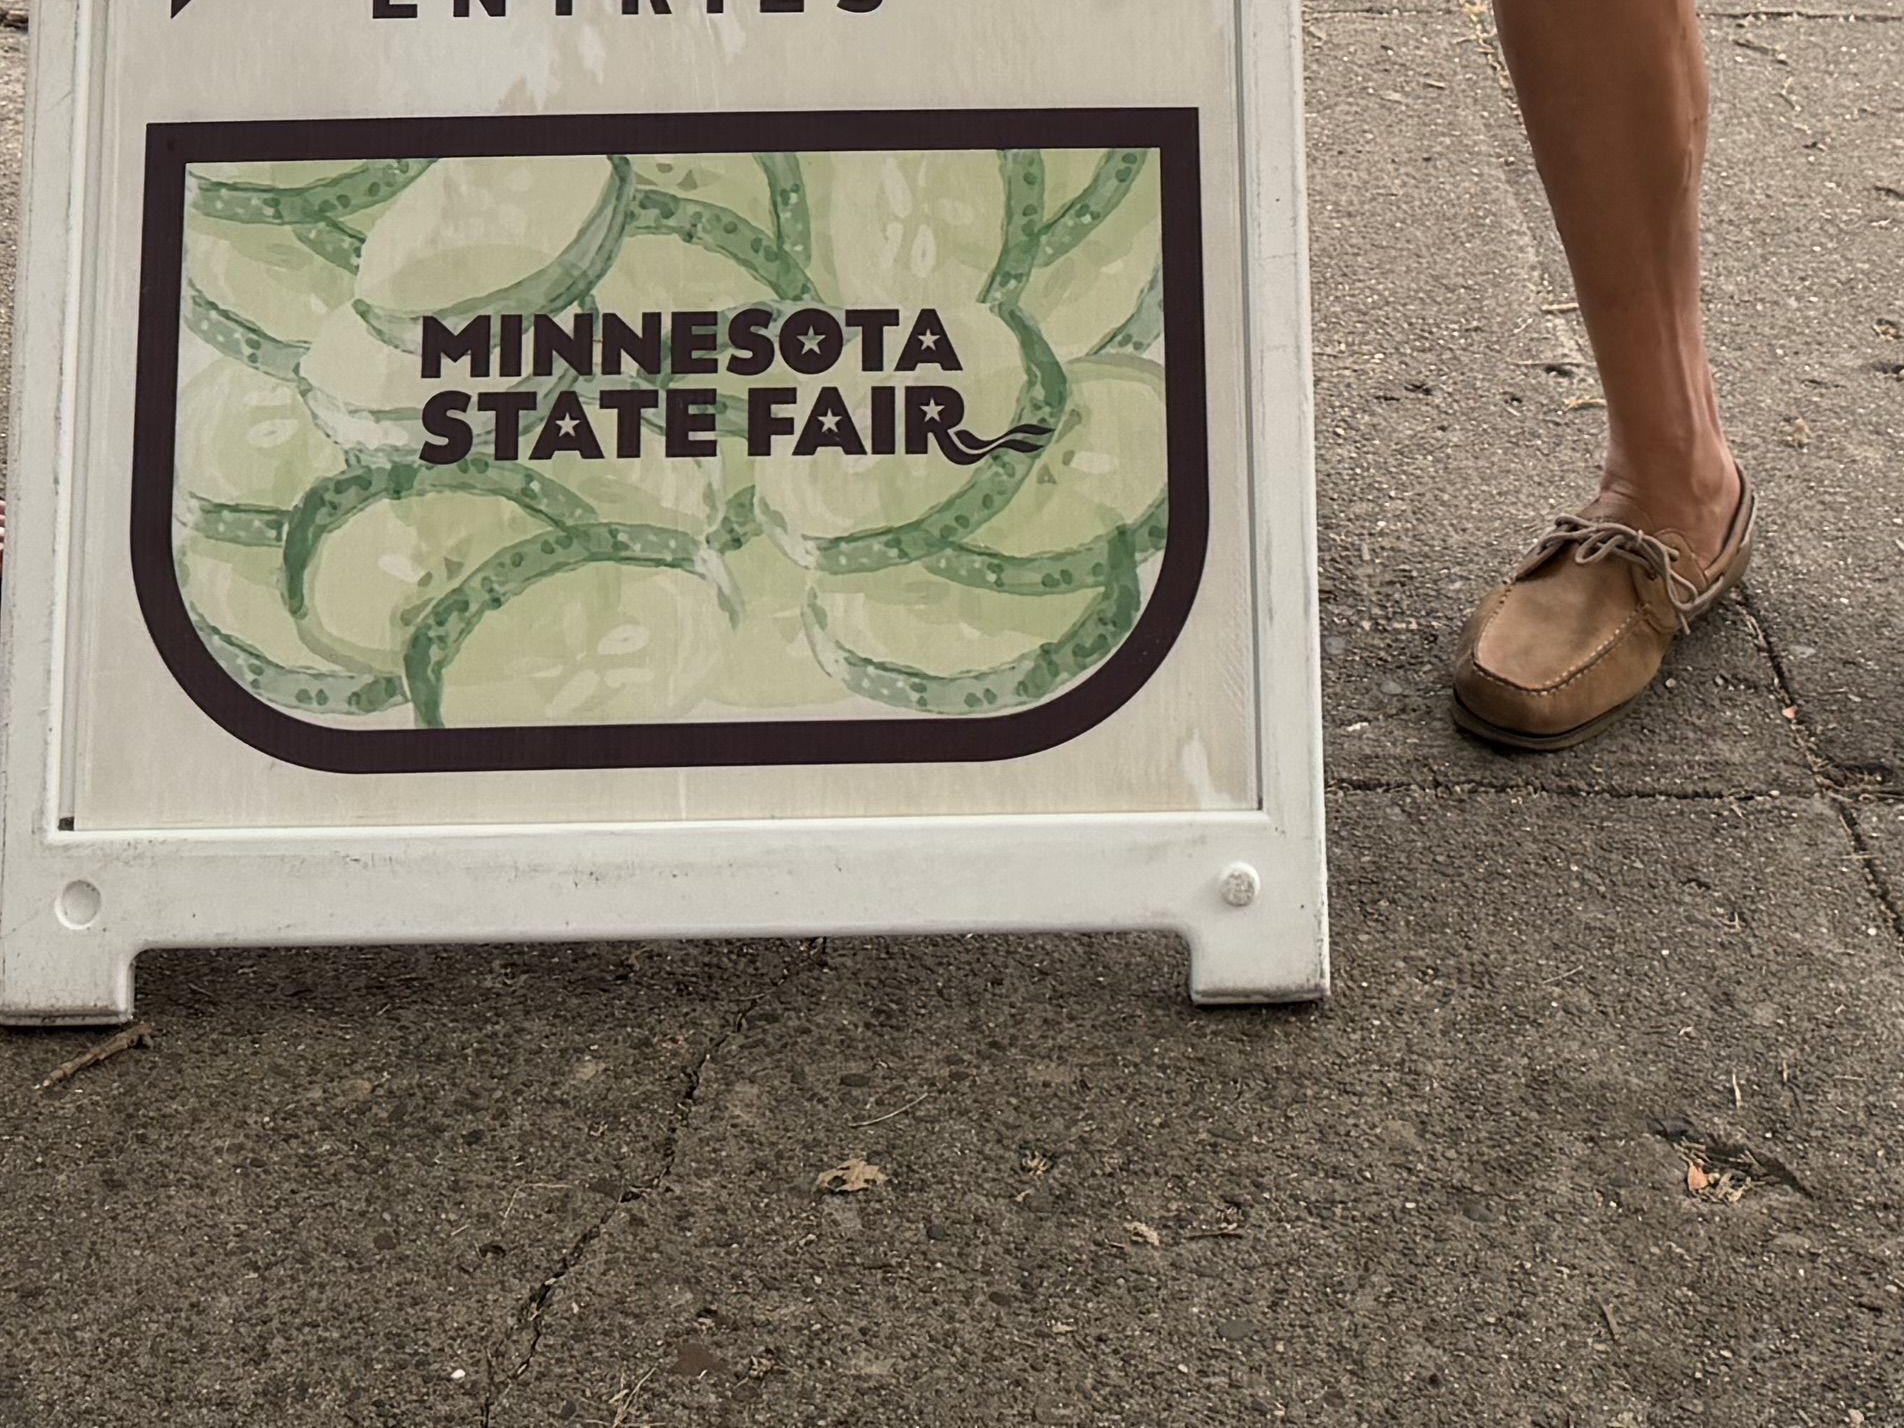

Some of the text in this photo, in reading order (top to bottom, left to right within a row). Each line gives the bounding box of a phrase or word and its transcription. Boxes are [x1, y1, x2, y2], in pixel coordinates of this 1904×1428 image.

[420, 307, 964, 379] MINNESOTA
[418, 385, 1055, 466] STATE FAIR
